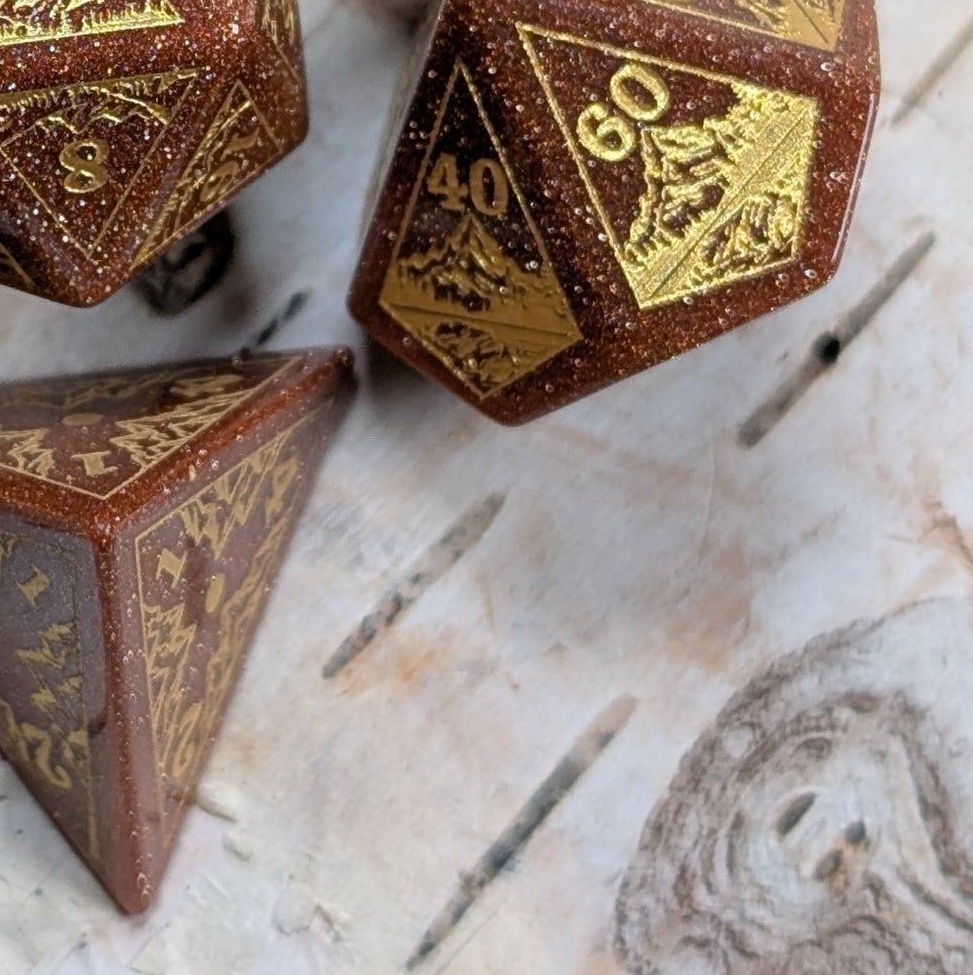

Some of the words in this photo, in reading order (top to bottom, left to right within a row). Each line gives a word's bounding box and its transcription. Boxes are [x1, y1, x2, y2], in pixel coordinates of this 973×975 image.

[575, 63, 672, 163] 60
[58, 138, 109, 195] 8
[427, 152, 509, 218] 40
